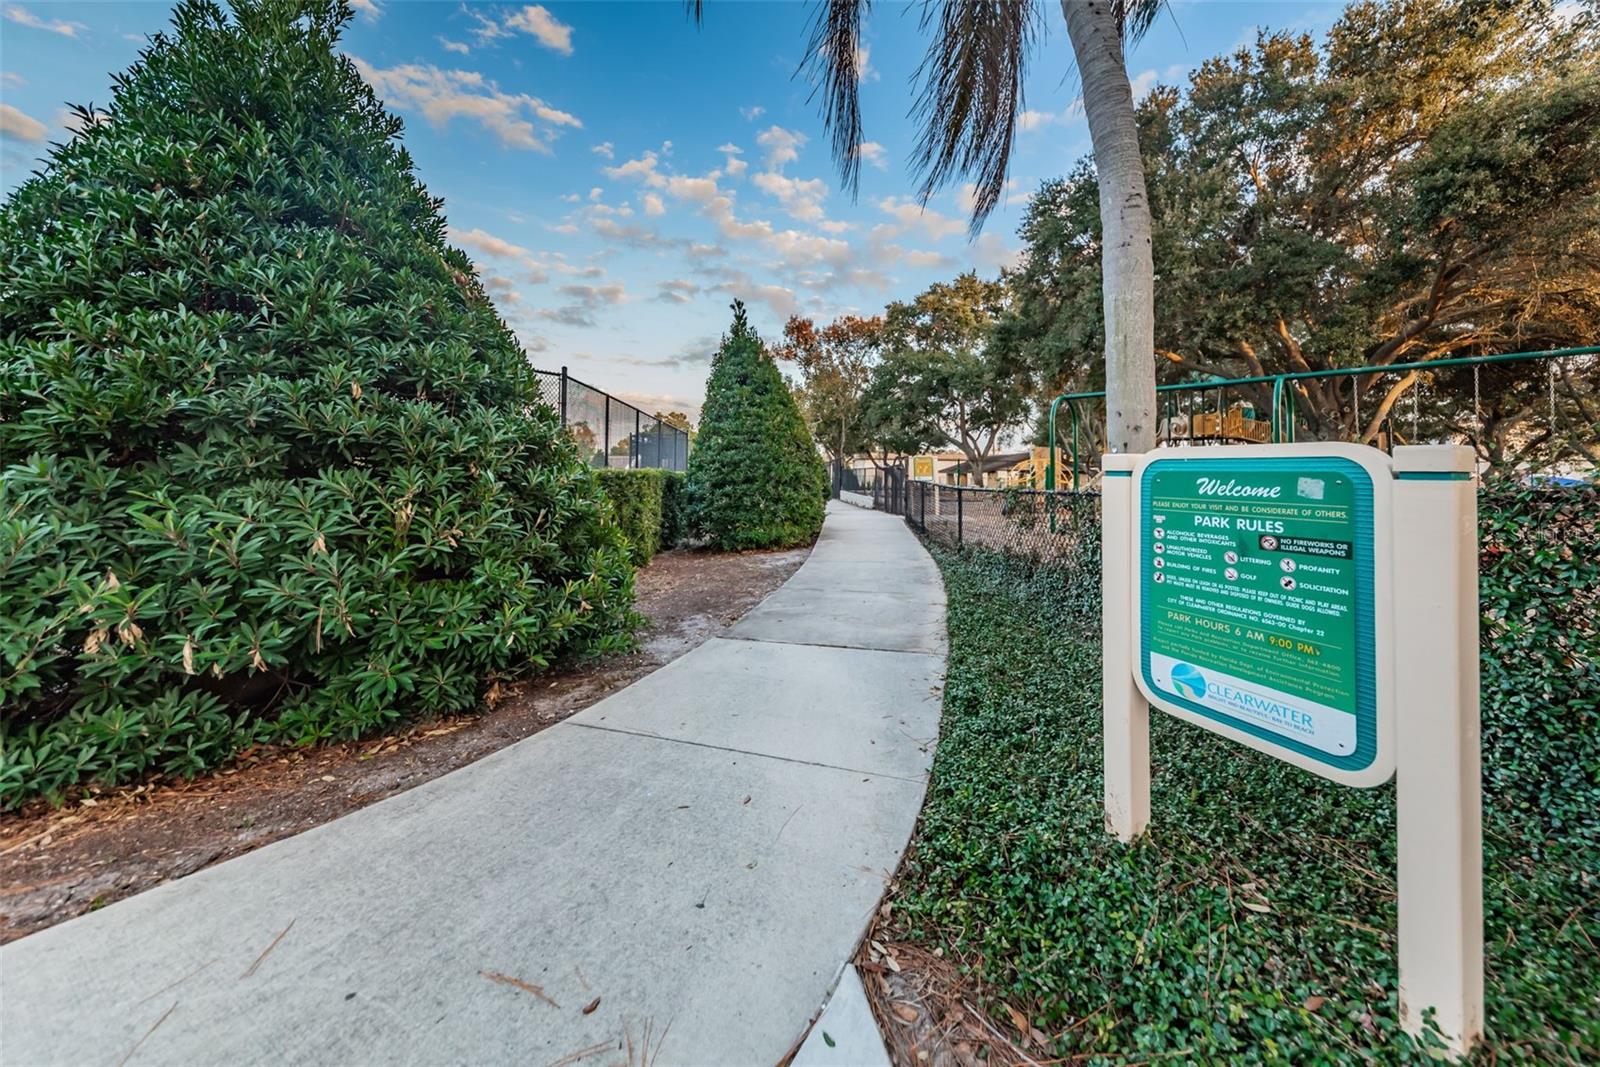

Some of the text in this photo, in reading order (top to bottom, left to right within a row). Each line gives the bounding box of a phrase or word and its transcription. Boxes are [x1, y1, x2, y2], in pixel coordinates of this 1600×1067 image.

[1196, 477, 1280, 498] Welcome
[1251, 506, 1298, 516] CONSIDERATE
[1315, 510, 1348, 518] OTHERS.
[1194, 515, 1284, 534] PARK RULES
[1166, 530, 1229, 540] ALCOHOLIC BEVERAGES
[1199, 538, 1236, 547] INTOXICANTS
[1293, 540, 1335, 548] FIREWORKS
[1166, 545, 1208, 554] UNAUTHORIZED
[1308, 548, 1346, 557] WEAPONS
[1187, 552, 1212, 560] VEHICLES
[1239, 556, 1272, 566] LITTERING
[1166, 562, 1190, 570] BUILDING
[1202, 566, 1217, 574] FIRES
[1299, 564, 1341, 575] PROFANITY
[1299, 582, 1349, 596] SOLICITATION
[1180, 594, 1194, 602] THESE
[1207, 600, 1224, 608] OTHER
[1225, 604, 1262, 616] REGULATIONS
[1263, 612, 1296, 624] GOVERNED
[1331, 604, 1348, 612] AREAS.
[1186, 601, 1216, 612] CLEARWATER
[1217, 608, 1248, 620] ORDINANCE
[1249, 614, 1260, 622] NO.
[1288, 623, 1314, 635] Chapter
[1316, 629, 1326, 638] 22
[1167, 612, 1315, 656] PARK HOURS 6 AM 9:00 PM
[1211, 634, 1241, 646] Recreation
[1242, 642, 1280, 654] Department
[1208, 682, 1313, 728] CLEARWATER
